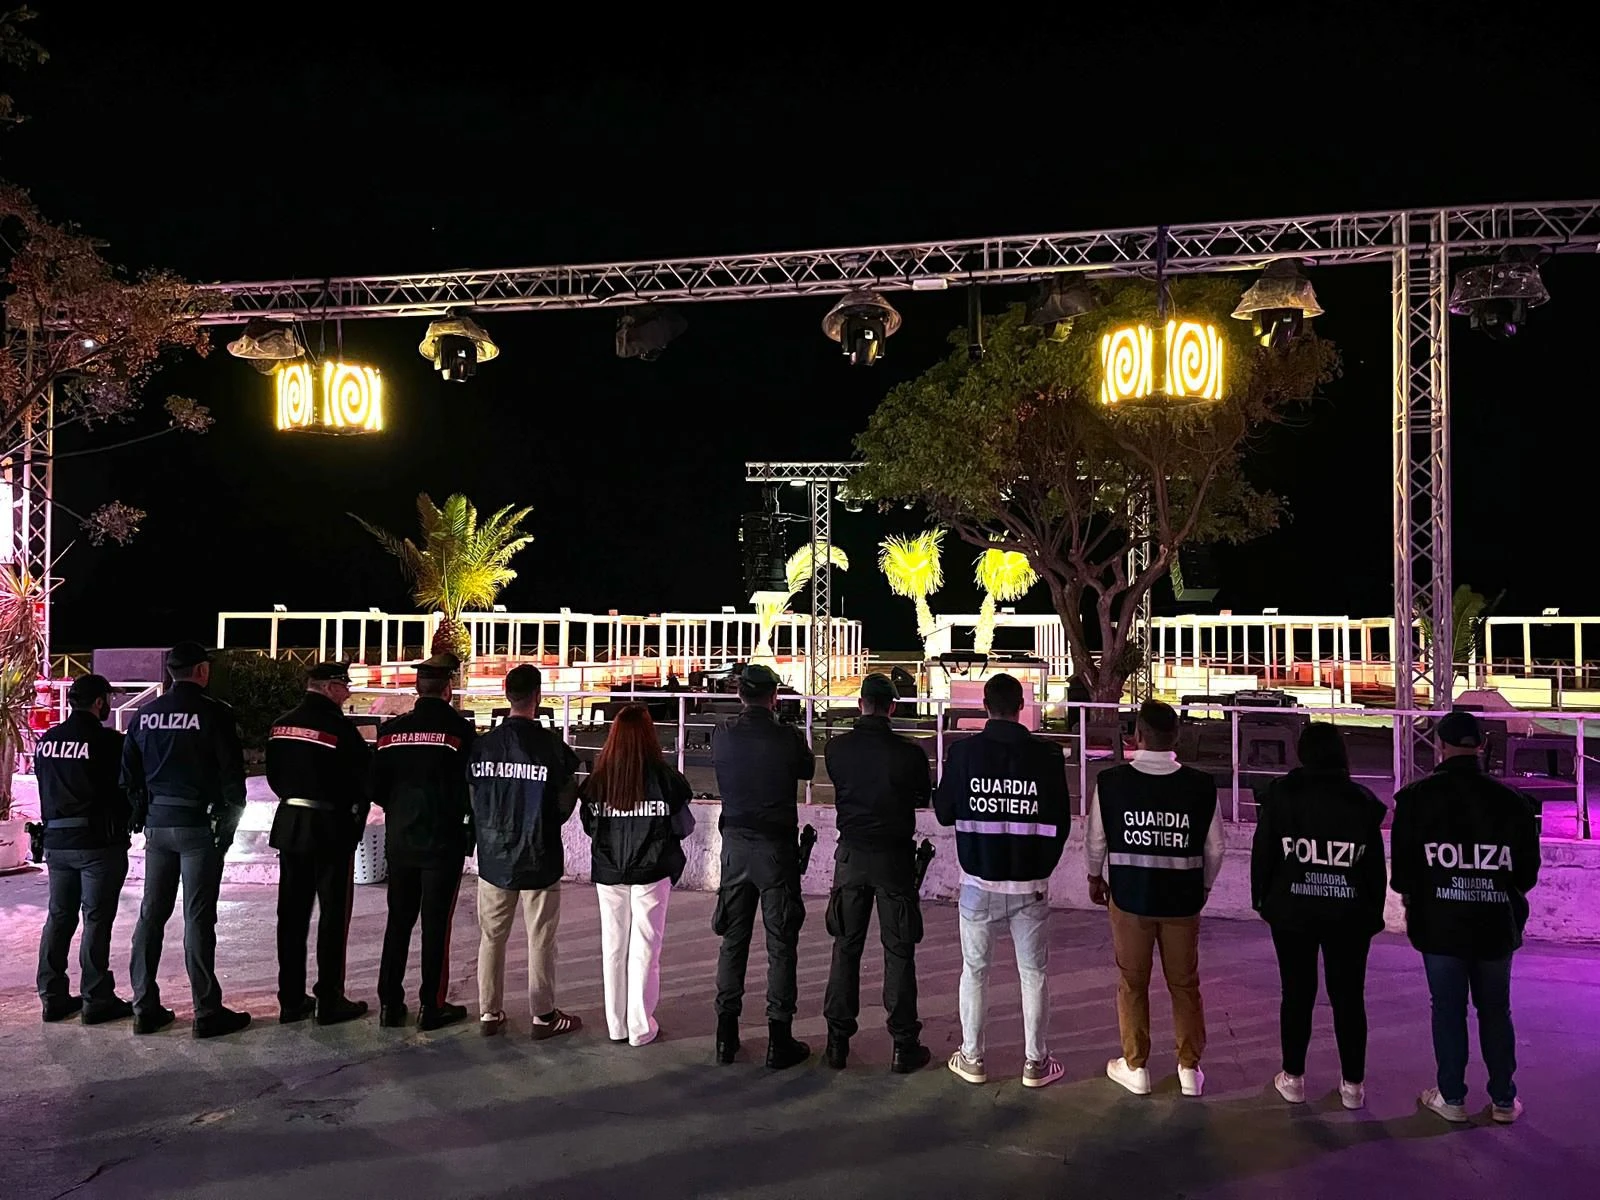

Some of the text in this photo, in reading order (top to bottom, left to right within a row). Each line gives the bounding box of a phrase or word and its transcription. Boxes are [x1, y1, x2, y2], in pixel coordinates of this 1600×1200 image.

[139, 713, 201, 730] POLIZIA
[391, 732, 446, 743] CARABINIERI
[35, 741, 90, 760] POLIZIA
[970, 777, 1038, 796] GUARDIA
[969, 796, 1039, 815] COSTIERA
[1123, 811, 1190, 829] GUARDIA
[1123, 830, 1190, 848] COSTIERA
[1305, 872, 1348, 886] SQUADRA
[1451, 876, 1494, 890] SQUADRA
